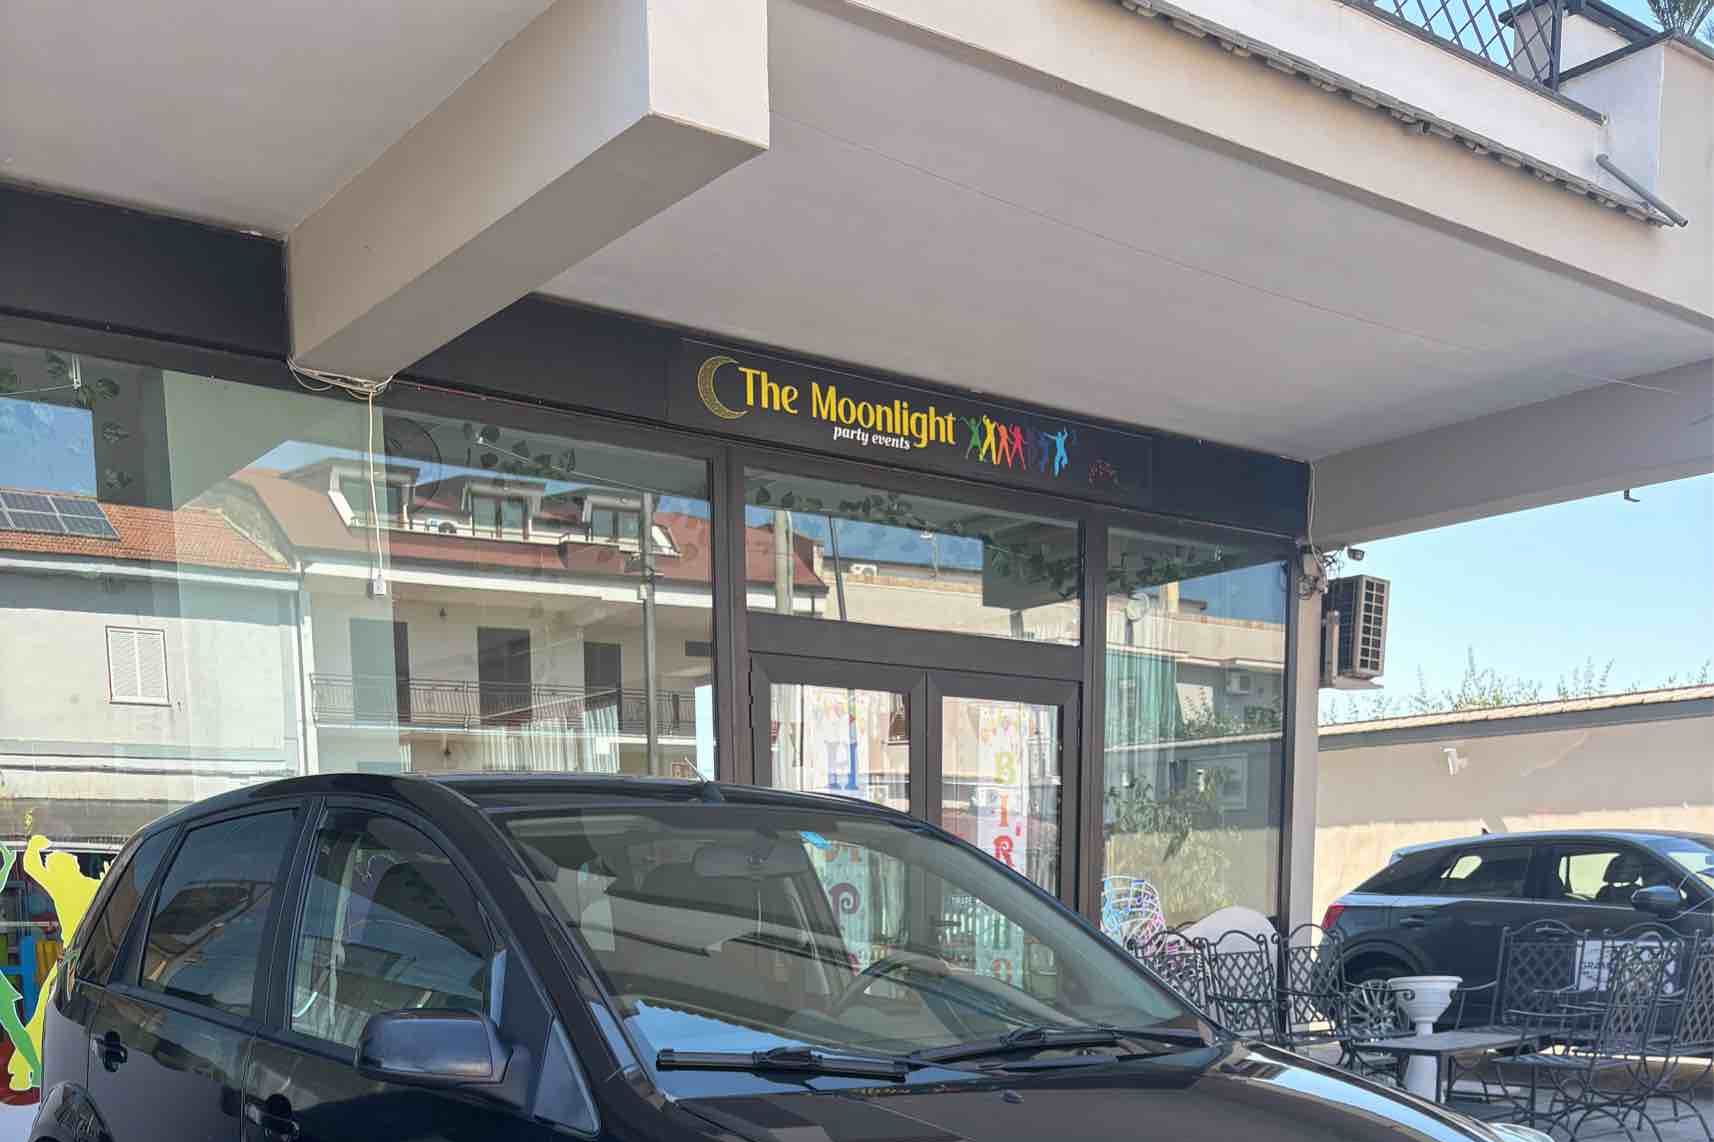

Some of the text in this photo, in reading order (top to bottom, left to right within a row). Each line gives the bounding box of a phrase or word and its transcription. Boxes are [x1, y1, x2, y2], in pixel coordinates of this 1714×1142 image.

[738, 367, 957, 448] The Moonlight
[833, 425, 911, 450] party events
